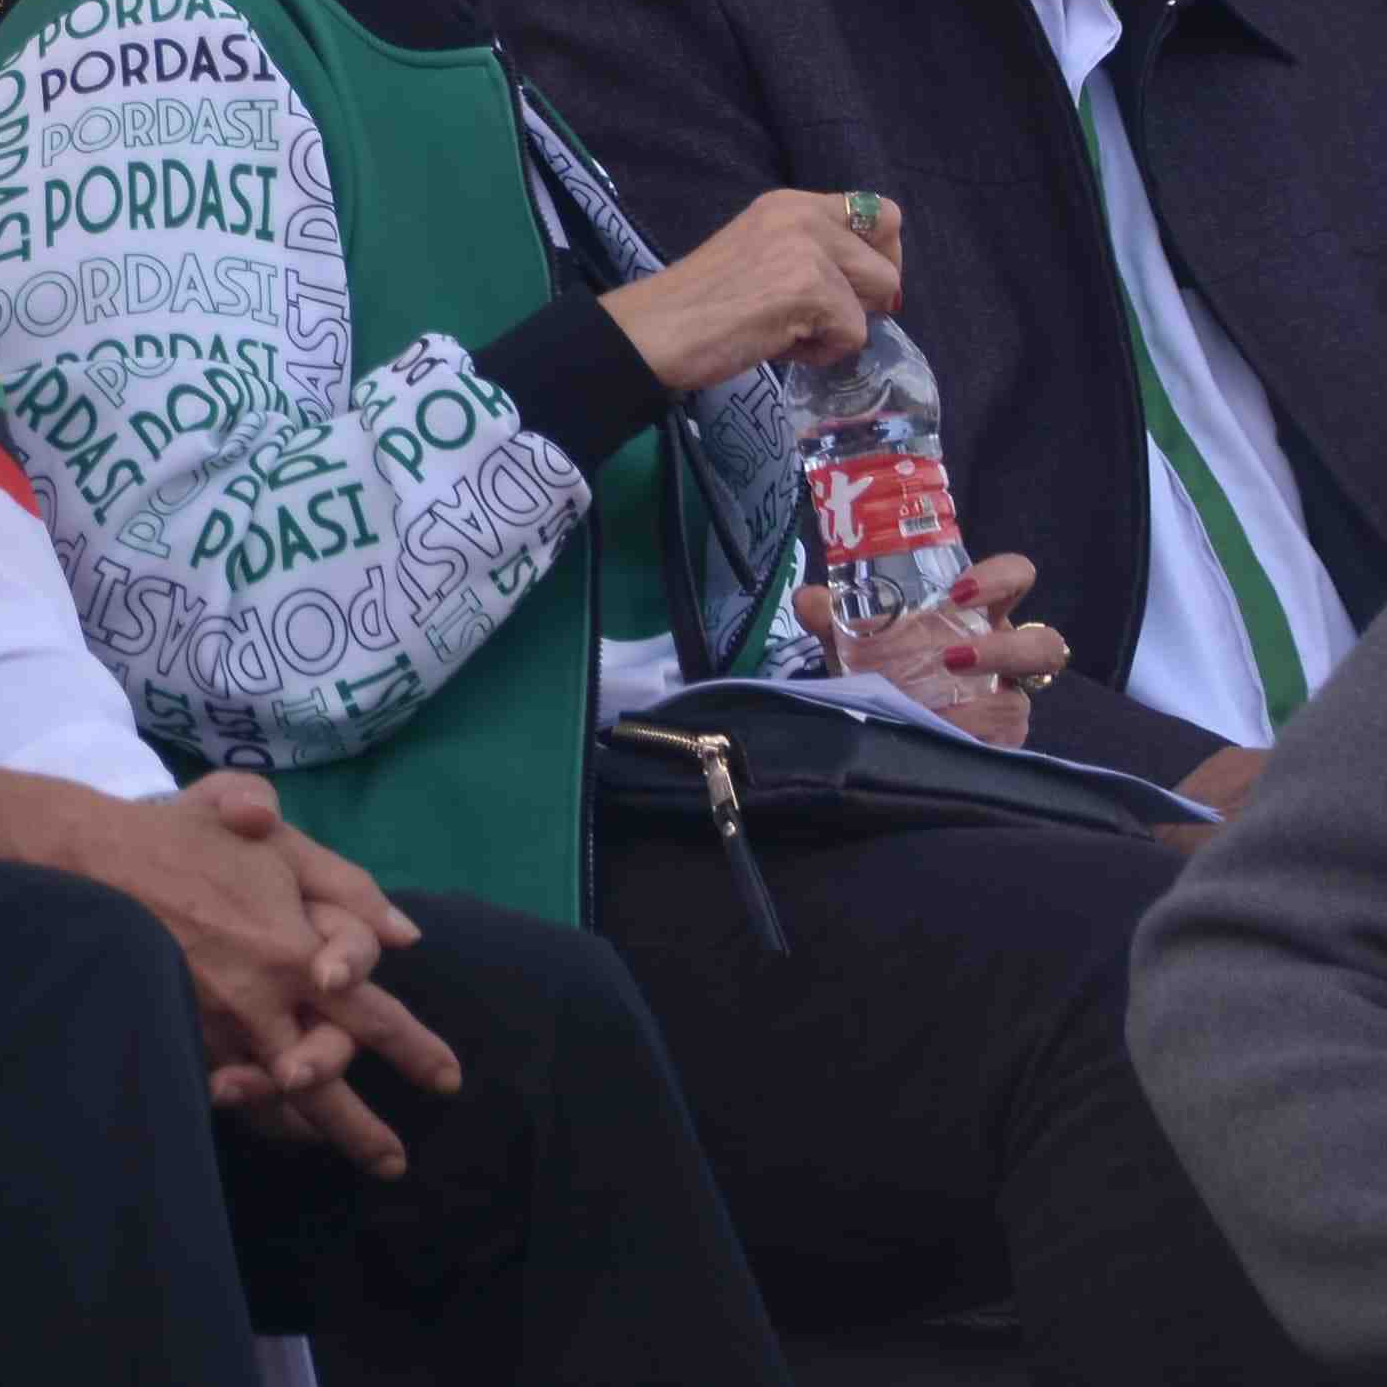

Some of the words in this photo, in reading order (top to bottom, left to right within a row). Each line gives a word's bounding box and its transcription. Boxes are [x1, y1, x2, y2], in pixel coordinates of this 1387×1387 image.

[40, 33, 276, 112] PORDASI
[41, 97, 279, 168] PORDASI
[44, 158, 278, 248] PORDASI
